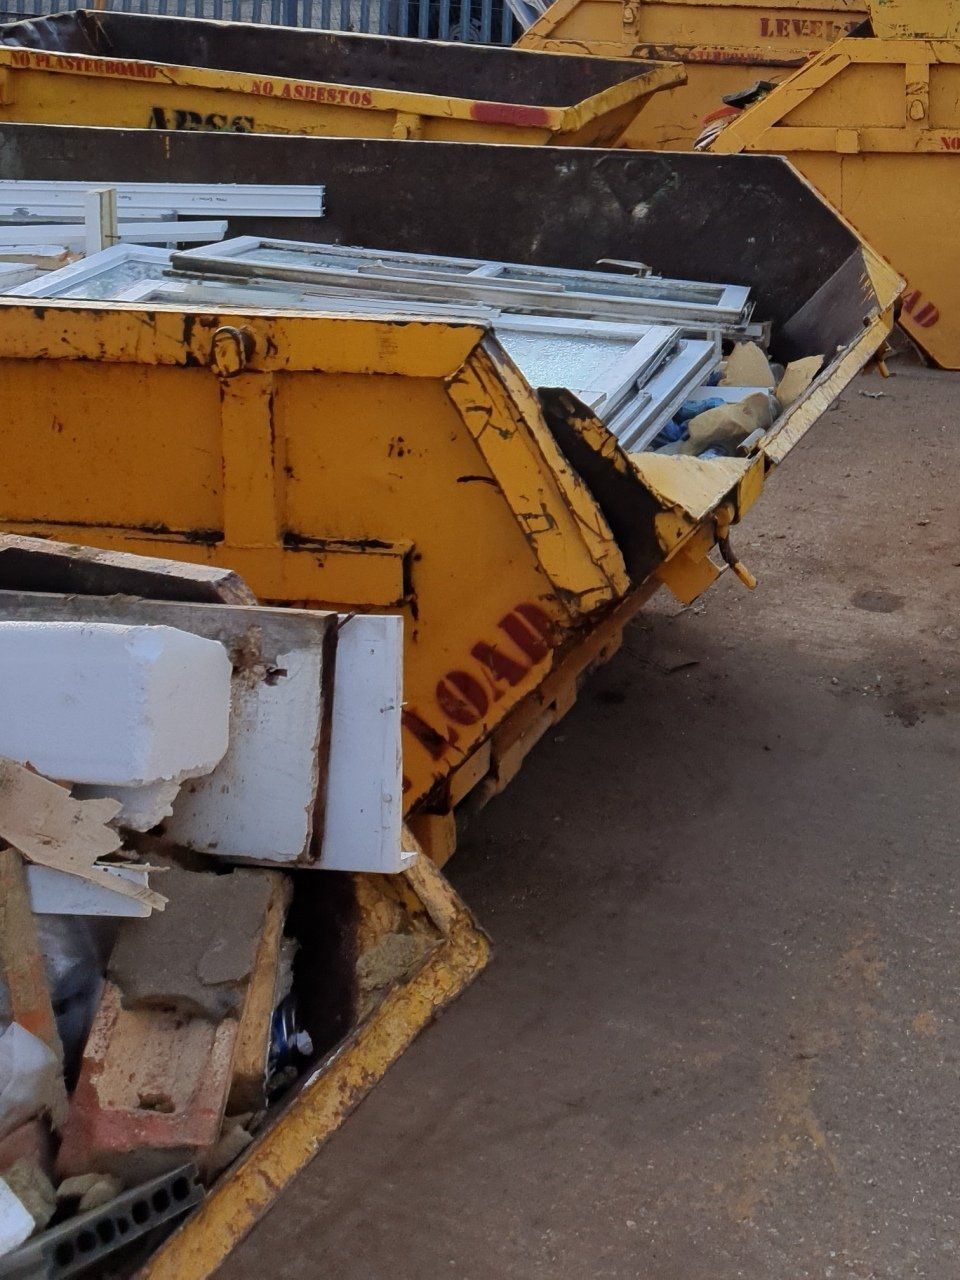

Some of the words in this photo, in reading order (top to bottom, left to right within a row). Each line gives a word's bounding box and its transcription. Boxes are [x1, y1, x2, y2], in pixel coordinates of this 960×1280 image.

[10, 51, 30, 67] NO
[251, 80, 274, 96] NO
[282, 82, 373, 107] ASBESTOS
[402, 602, 557, 761] LOAD
